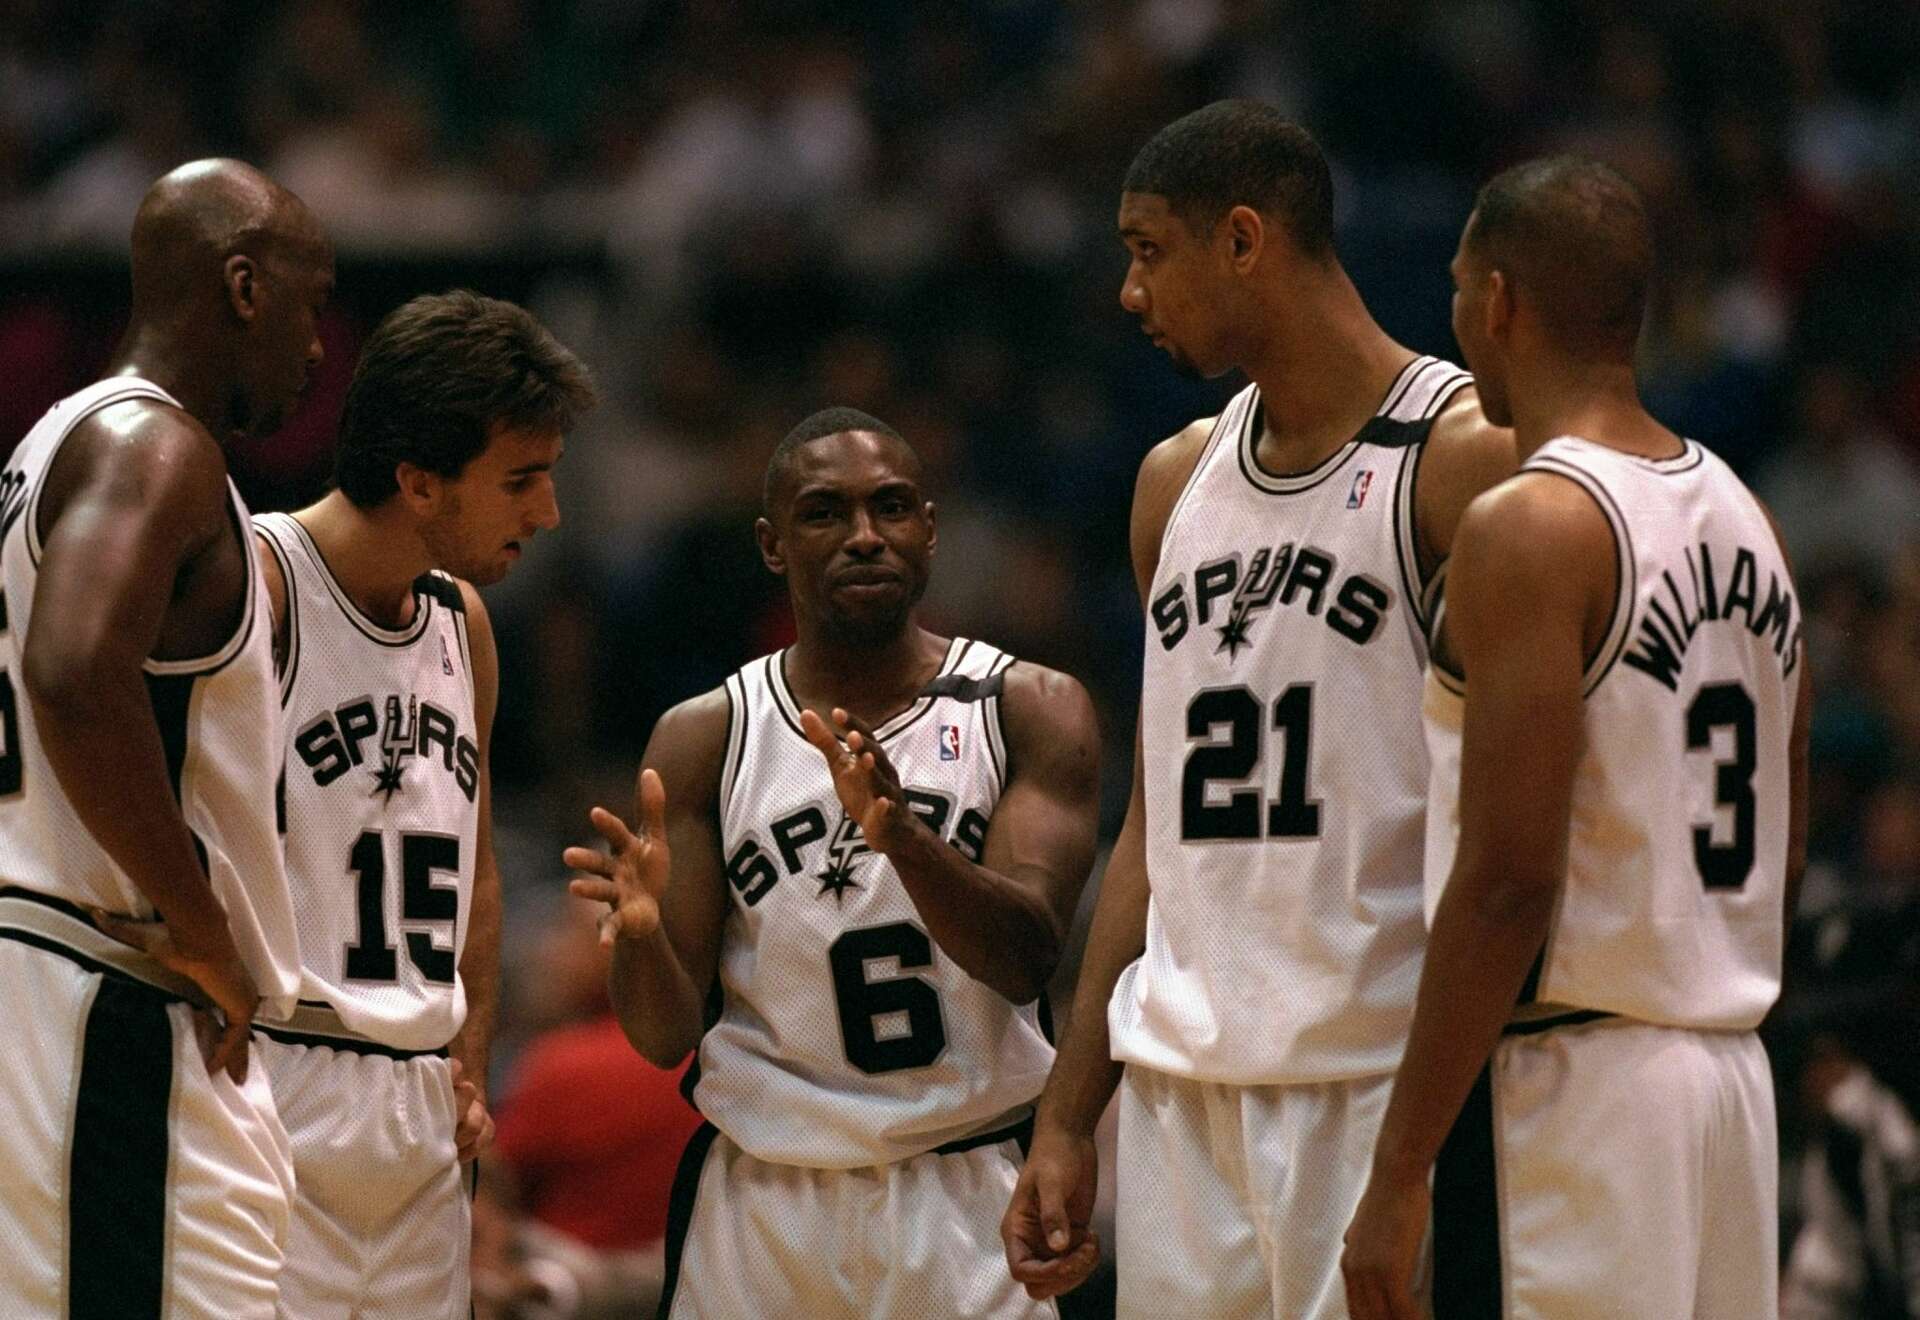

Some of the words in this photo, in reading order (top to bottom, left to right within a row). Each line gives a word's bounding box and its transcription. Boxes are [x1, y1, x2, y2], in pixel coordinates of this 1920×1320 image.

[1151, 542, 1394, 665] SPURS
[1622, 542, 1802, 692] WILLIAMS
[295, 694, 480, 803] SPURS
[1181, 682, 1325, 845] 21
[1685, 680, 1758, 893] 3
[341, 828, 460, 986] 15
[828, 919, 951, 1077] 6
